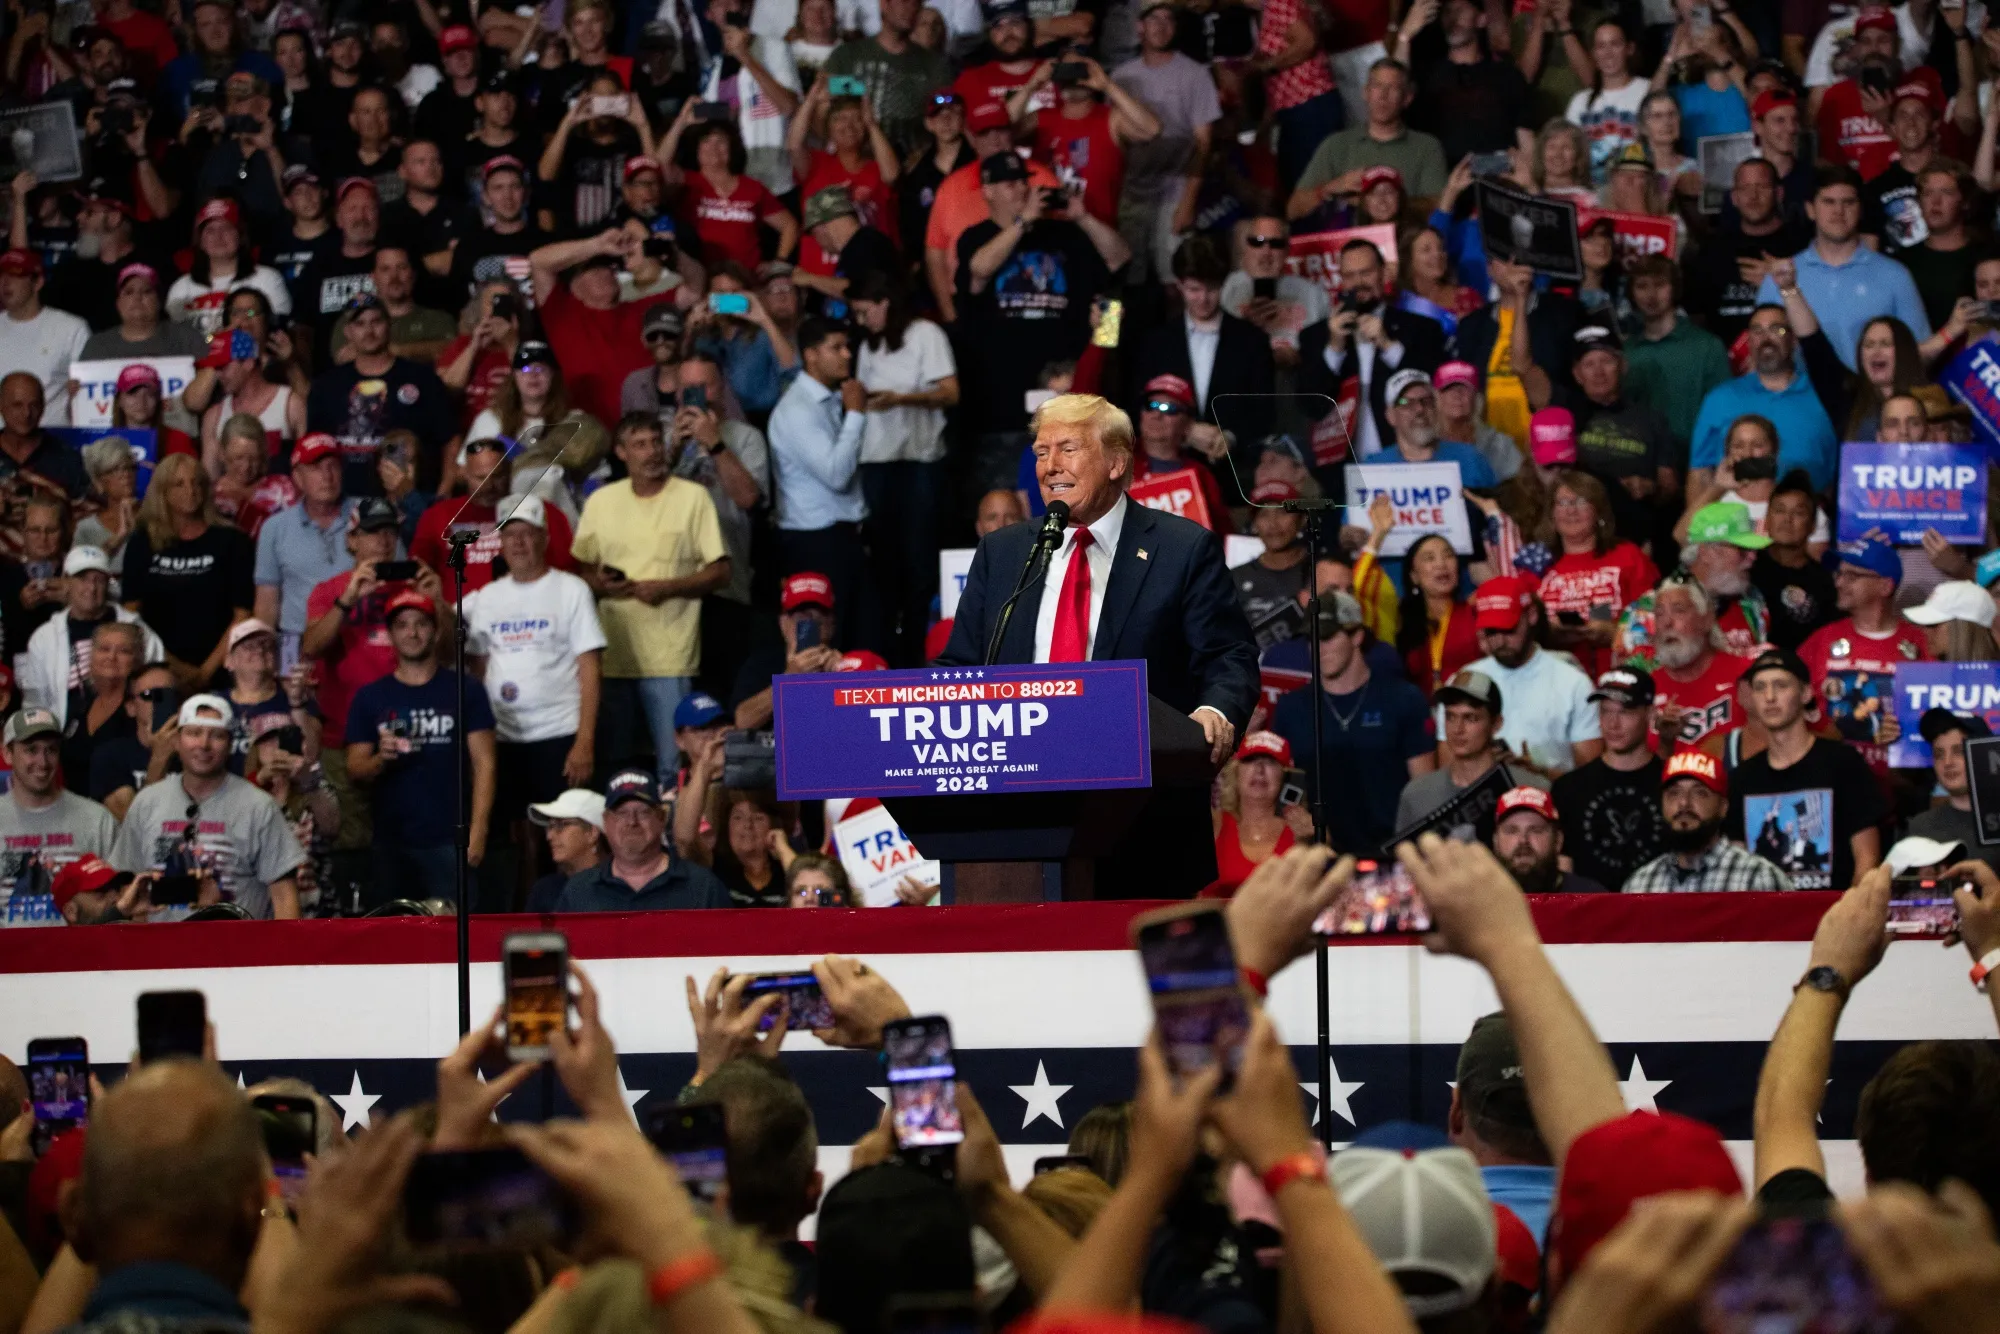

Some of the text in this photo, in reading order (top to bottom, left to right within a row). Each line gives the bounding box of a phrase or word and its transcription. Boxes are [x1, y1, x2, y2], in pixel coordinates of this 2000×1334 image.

[85, 378, 183, 399] TRP
[1852, 464, 1977, 490] TRUMP
[1866, 489, 1963, 511] VANCE
[490, 618, 549, 634] TRUMP
[841, 681, 1077, 704] TEXT MICHIGAN TO 88022
[870, 702, 1049, 741] TRUMP
[1649, 694, 1732, 744] SA
[912, 741, 1008, 764] VANCE
[885, 763, 1039, 777] MAKE AMERICA GREAT AGAIN!
[1668, 752, 1717, 779] MAGA
[936, 776, 988, 792] 2024
